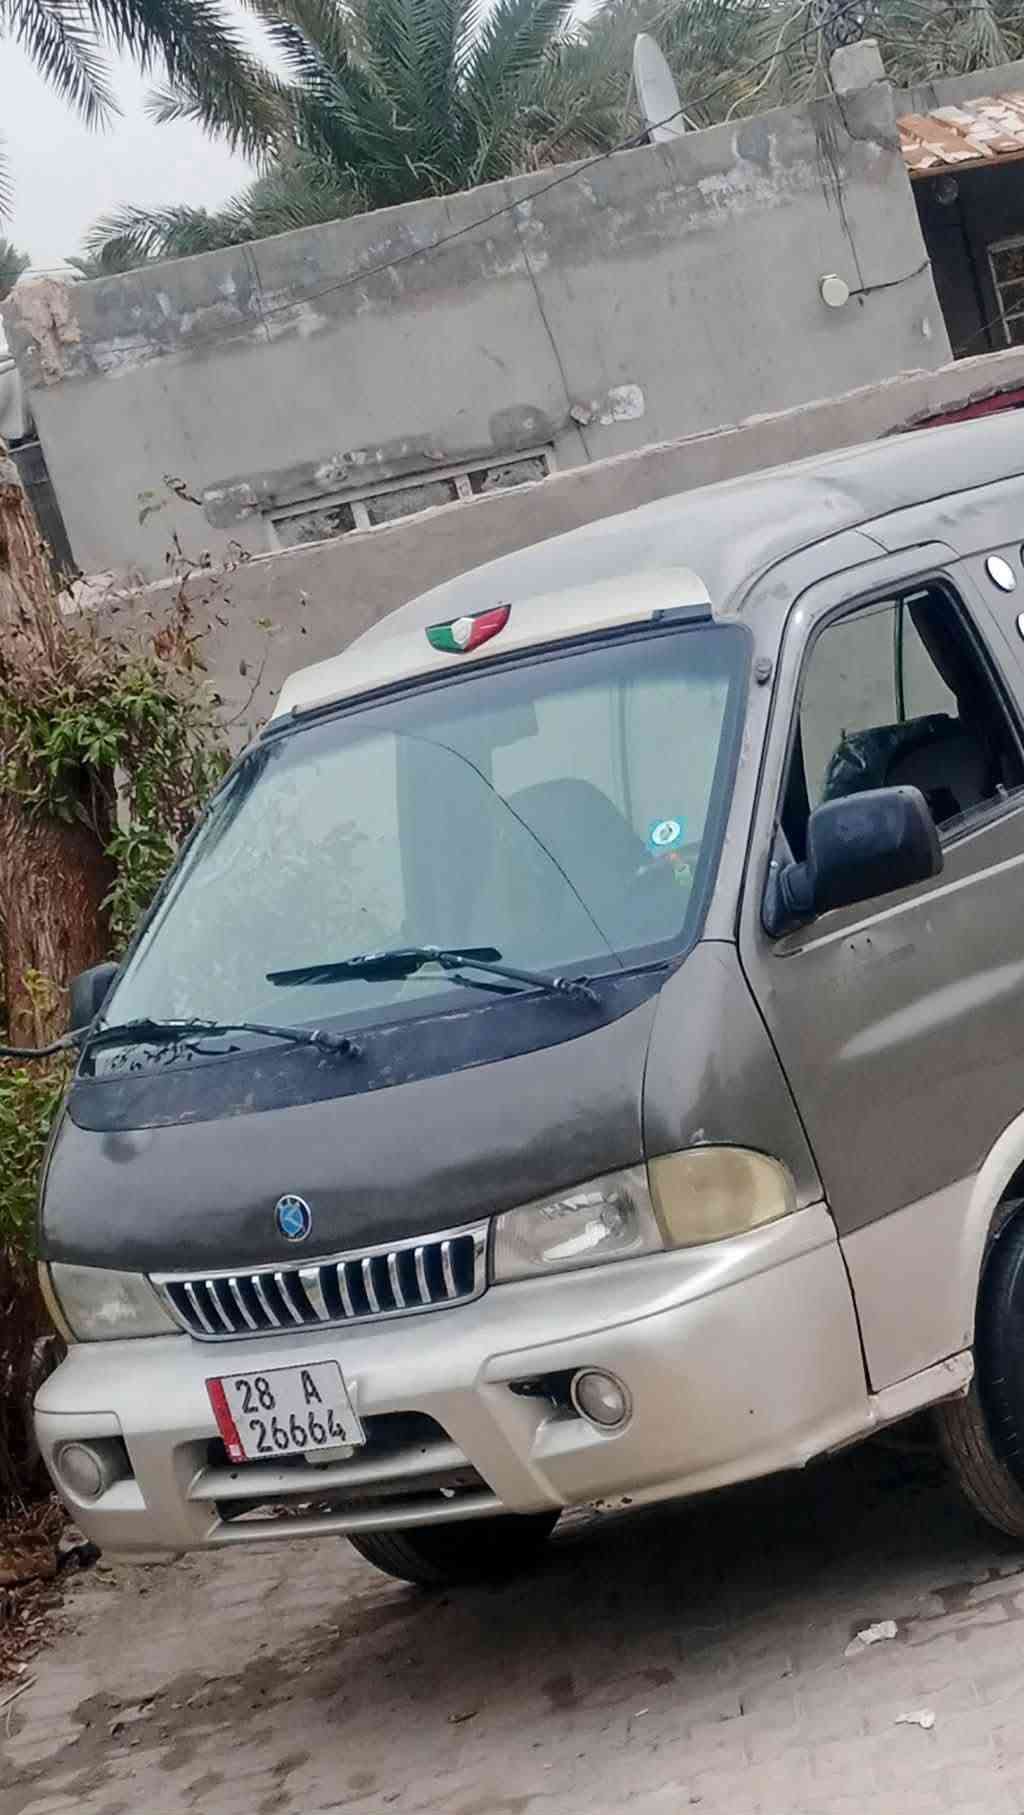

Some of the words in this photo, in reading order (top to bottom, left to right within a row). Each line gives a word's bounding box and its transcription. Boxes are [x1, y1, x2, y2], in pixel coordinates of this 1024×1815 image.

[235, 1377, 276, 1413] 28
[300, 1370, 322, 1404] A
[250, 1409, 347, 1453] 26664
